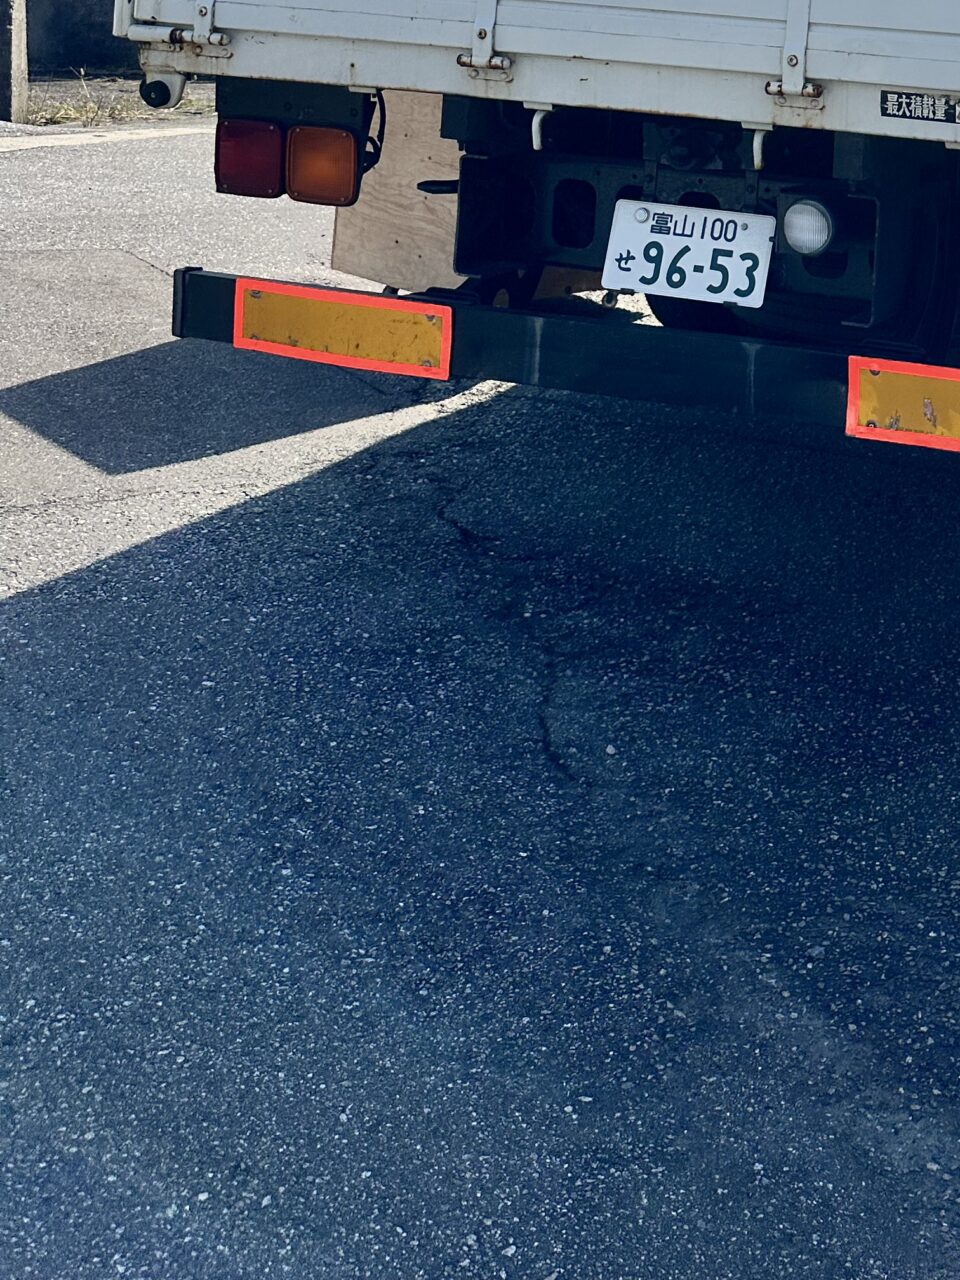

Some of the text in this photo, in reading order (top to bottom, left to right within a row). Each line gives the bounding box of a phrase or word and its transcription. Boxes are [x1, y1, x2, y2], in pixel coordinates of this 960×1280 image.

[884, 93, 948, 120] 最大積載量
[639, 241, 759, 297] 96-53
